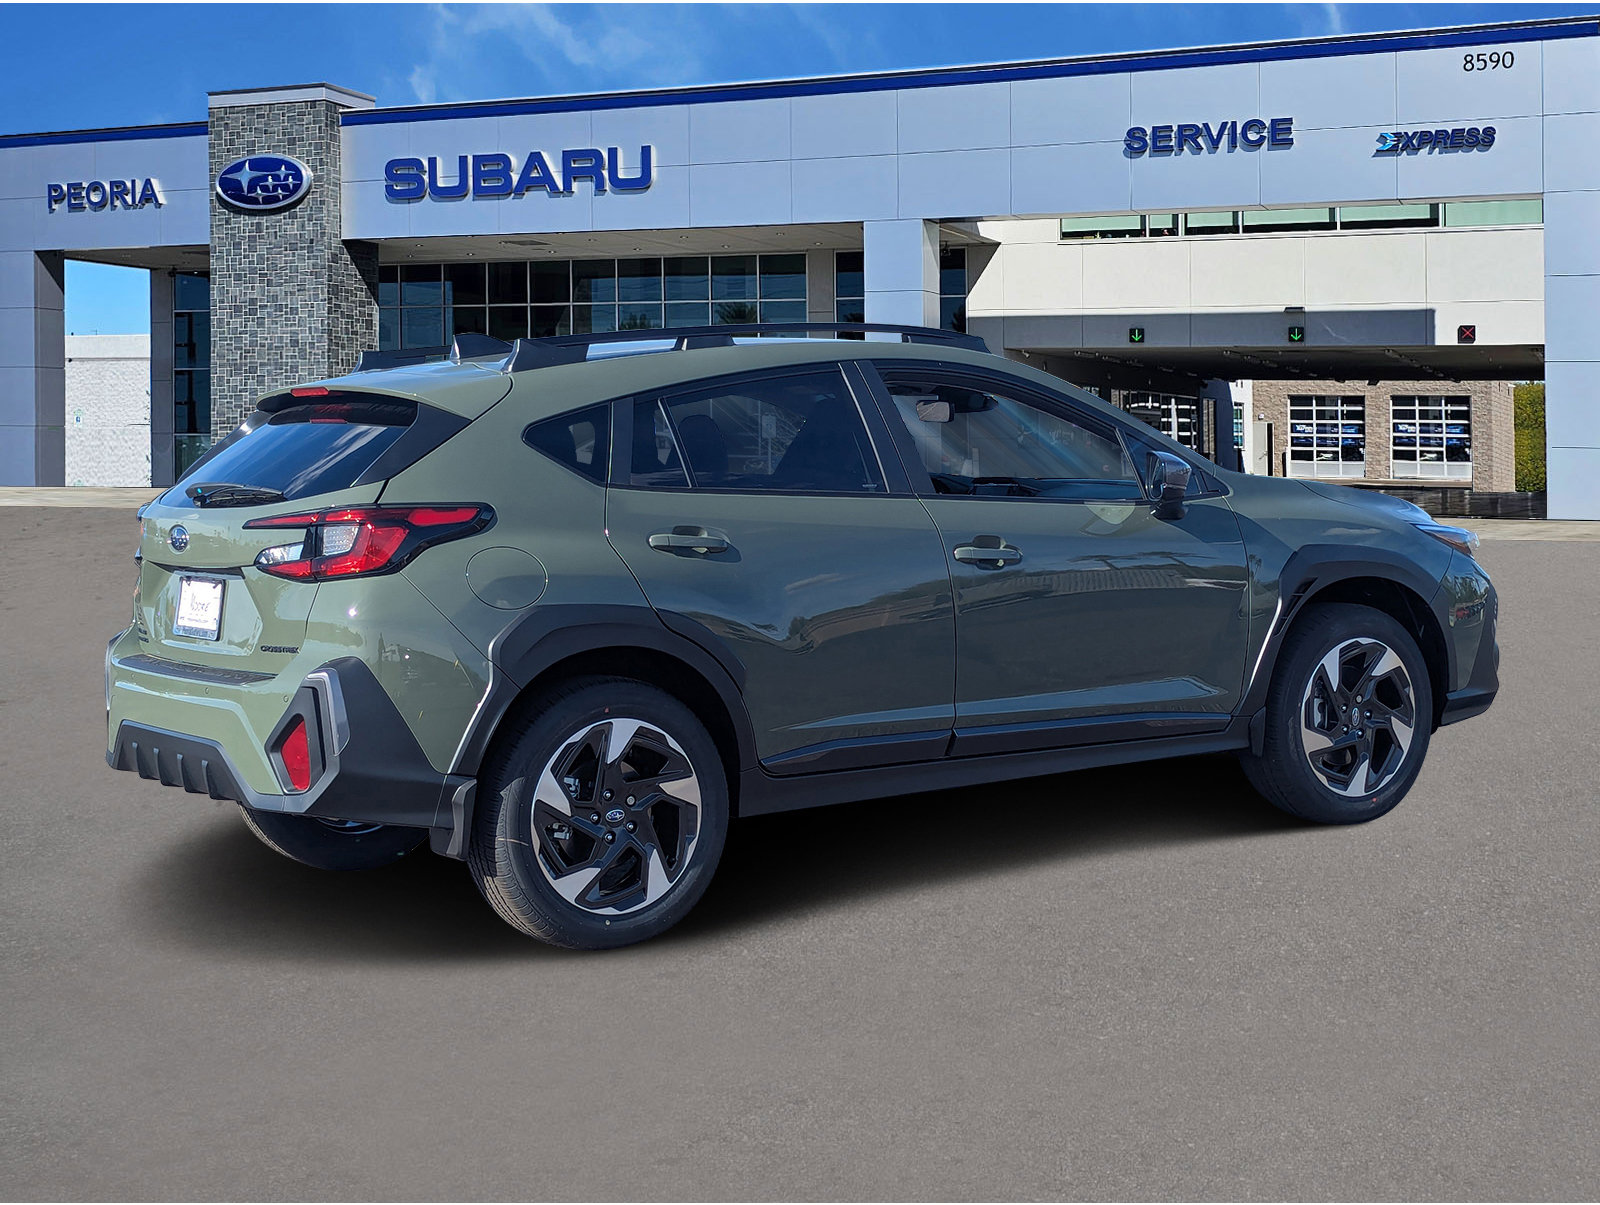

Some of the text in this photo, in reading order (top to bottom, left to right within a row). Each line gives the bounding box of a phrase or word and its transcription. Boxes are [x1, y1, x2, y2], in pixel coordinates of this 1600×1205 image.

[1463, 51, 1515, 72] 8590
[1124, 117, 1294, 156] SERVICE
[1375, 126, 1497, 154] EXPRESS
[384, 145, 653, 200] SUBARU
[47, 178, 163, 212] PEORIA
